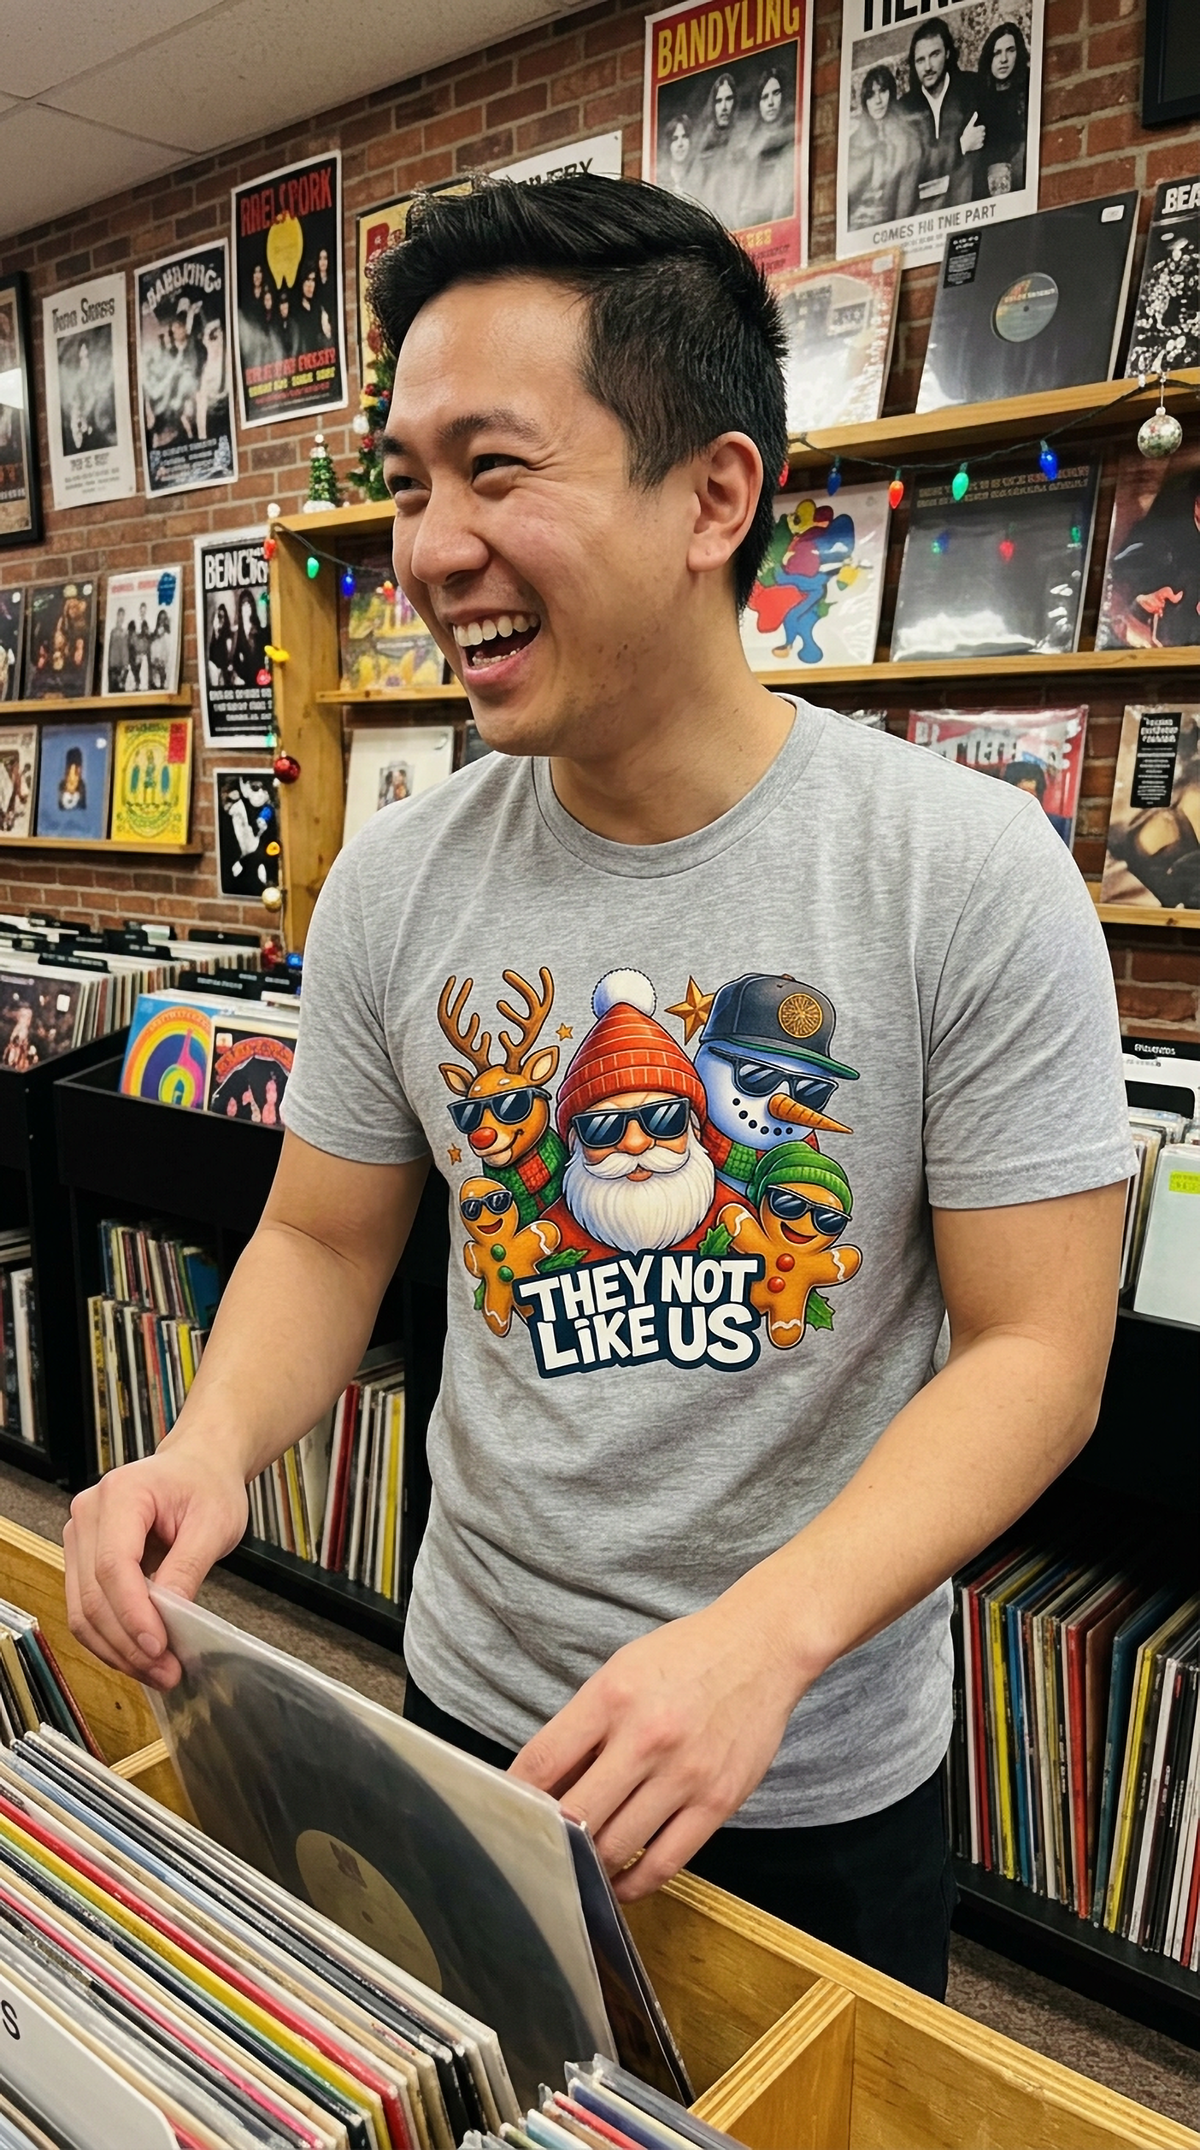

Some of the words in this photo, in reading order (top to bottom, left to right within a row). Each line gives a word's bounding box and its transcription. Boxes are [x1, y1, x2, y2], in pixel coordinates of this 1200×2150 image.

[657, 0, 800, 78] BANDYLING
[872, 223, 914, 245] COMES
[965, 203, 997, 224] PART
[518, 1255, 655, 1323] THEY
[661, 1255, 758, 1304] NOT
[668, 1303, 754, 1364] US
[0, 1999, 21, 2041] S
